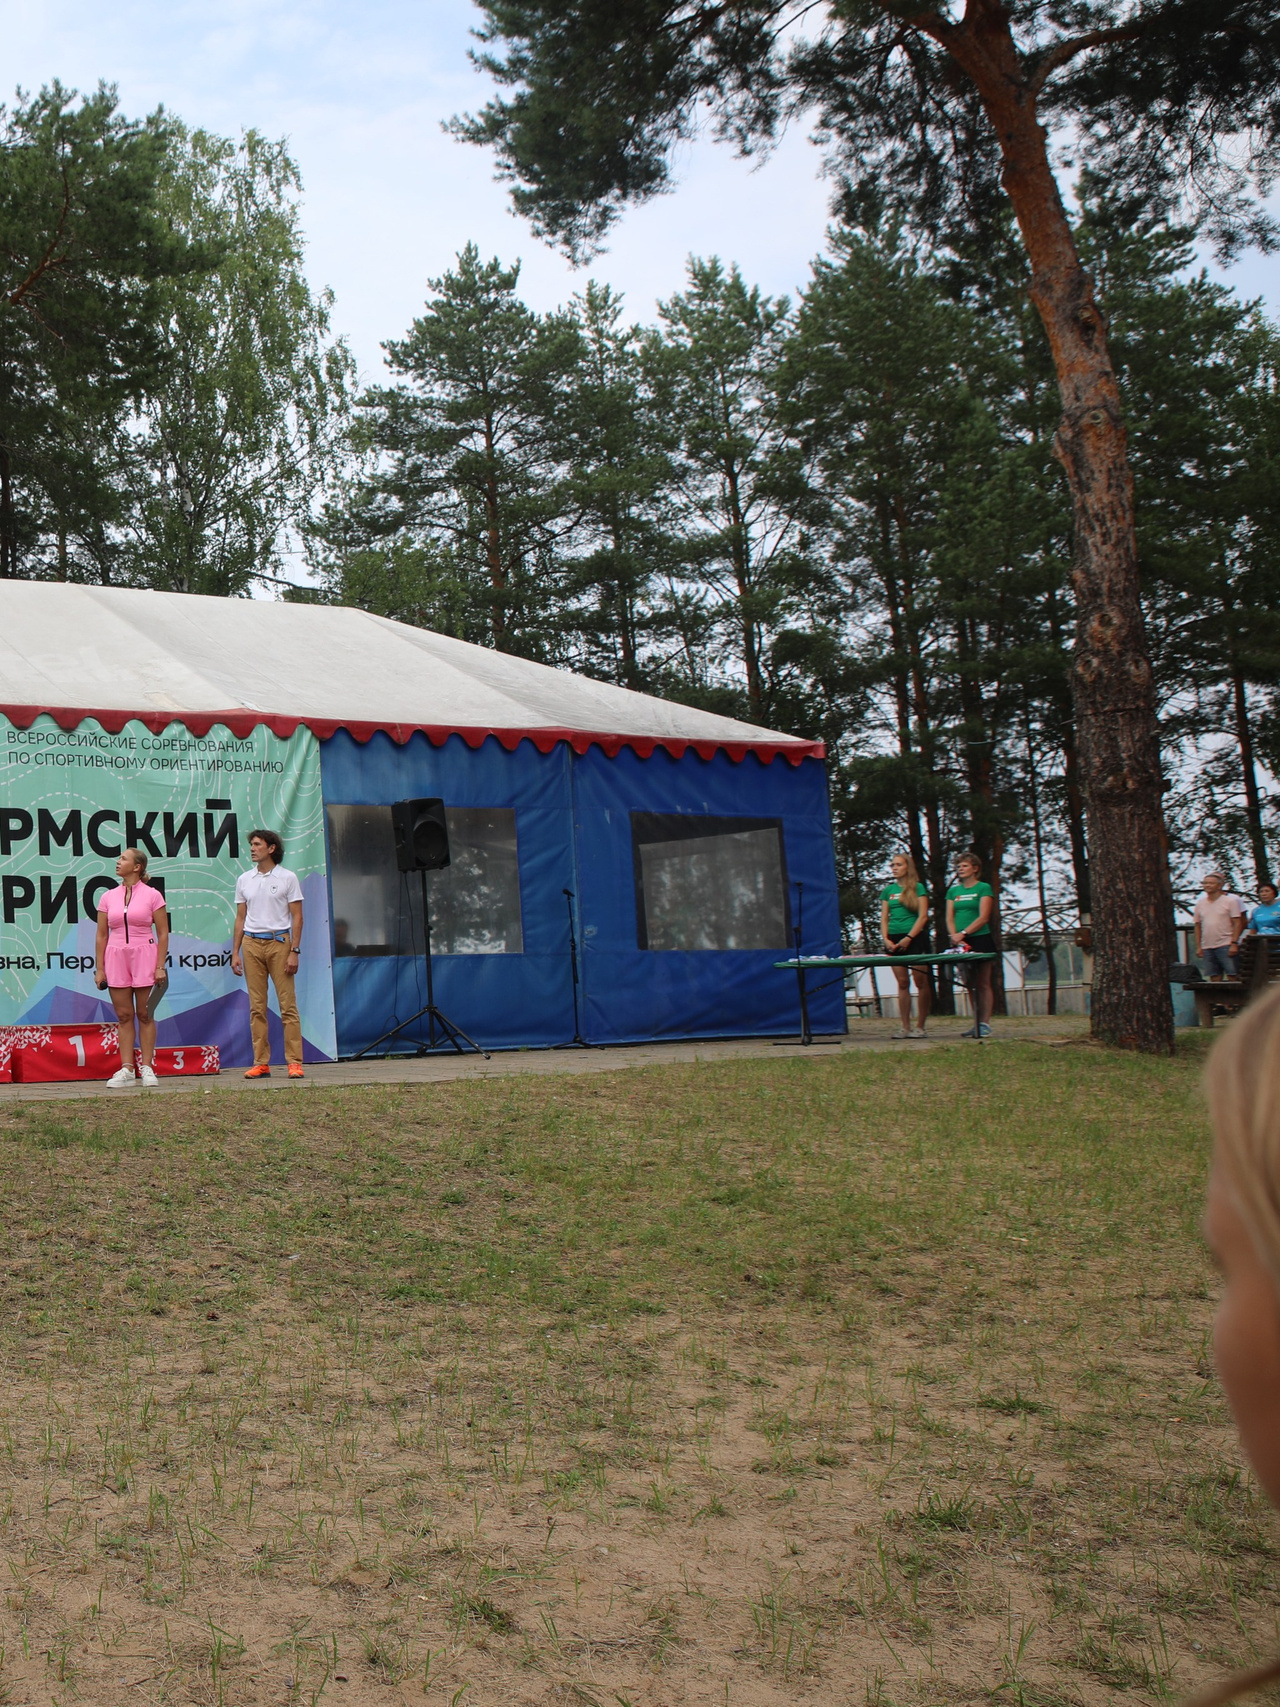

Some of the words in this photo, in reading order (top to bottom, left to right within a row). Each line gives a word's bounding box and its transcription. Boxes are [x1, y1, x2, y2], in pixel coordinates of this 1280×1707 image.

[7, 731, 137, 749] ВСЕРОССИЙСКИЕ
[142, 738, 254, 753] СОРЕВНОВАНИЯ
[8, 752, 30, 764] ПО
[35, 753, 146, 769] СПОРТИВНОМУ
[150, 758, 284, 773] ОРИЕНТИРОВАНИЮ
[180, 950, 233, 971] край
[68, 1035, 87, 1067] 1
[172, 1051, 185, 1070] 3
